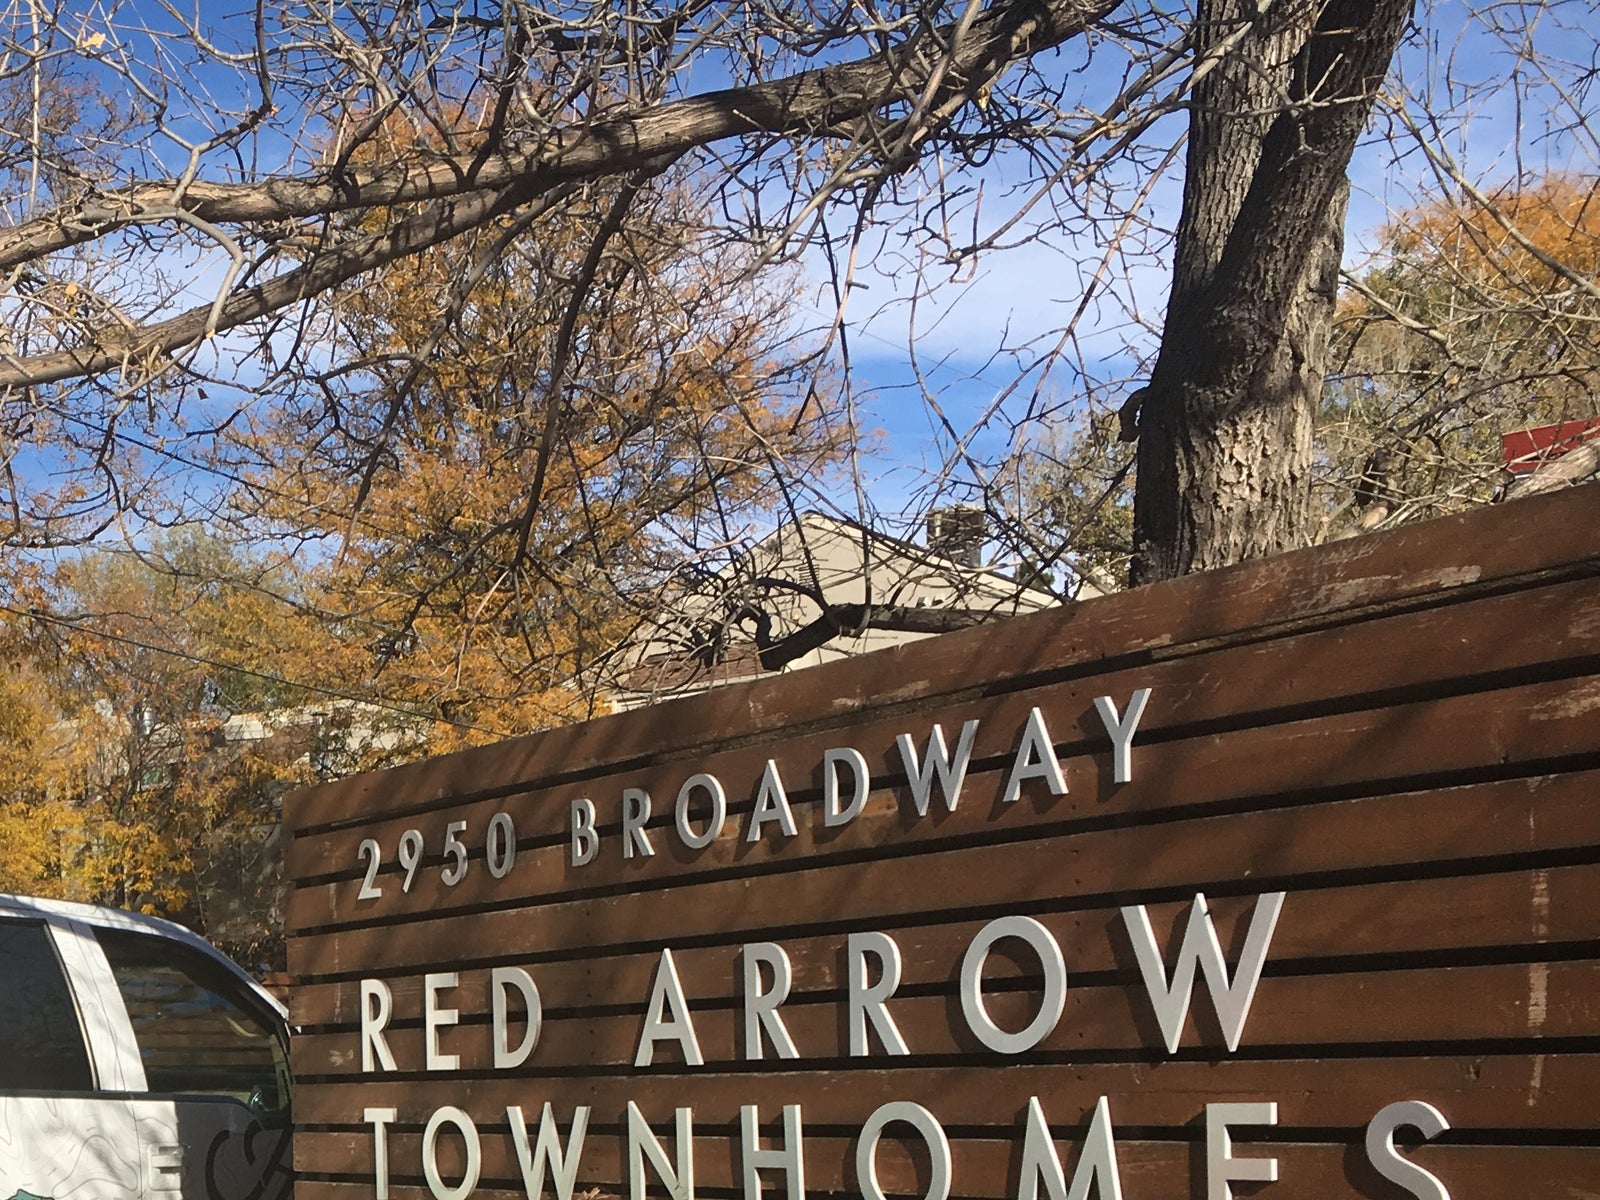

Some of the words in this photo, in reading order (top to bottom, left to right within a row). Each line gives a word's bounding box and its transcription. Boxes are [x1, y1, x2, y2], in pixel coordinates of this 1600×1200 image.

[357, 812, 516, 901] 2950
[571, 688, 1152, 867] BROADWAY
[361, 966, 543, 1072] RED
[634, 890, 1287, 1068] ARROW
